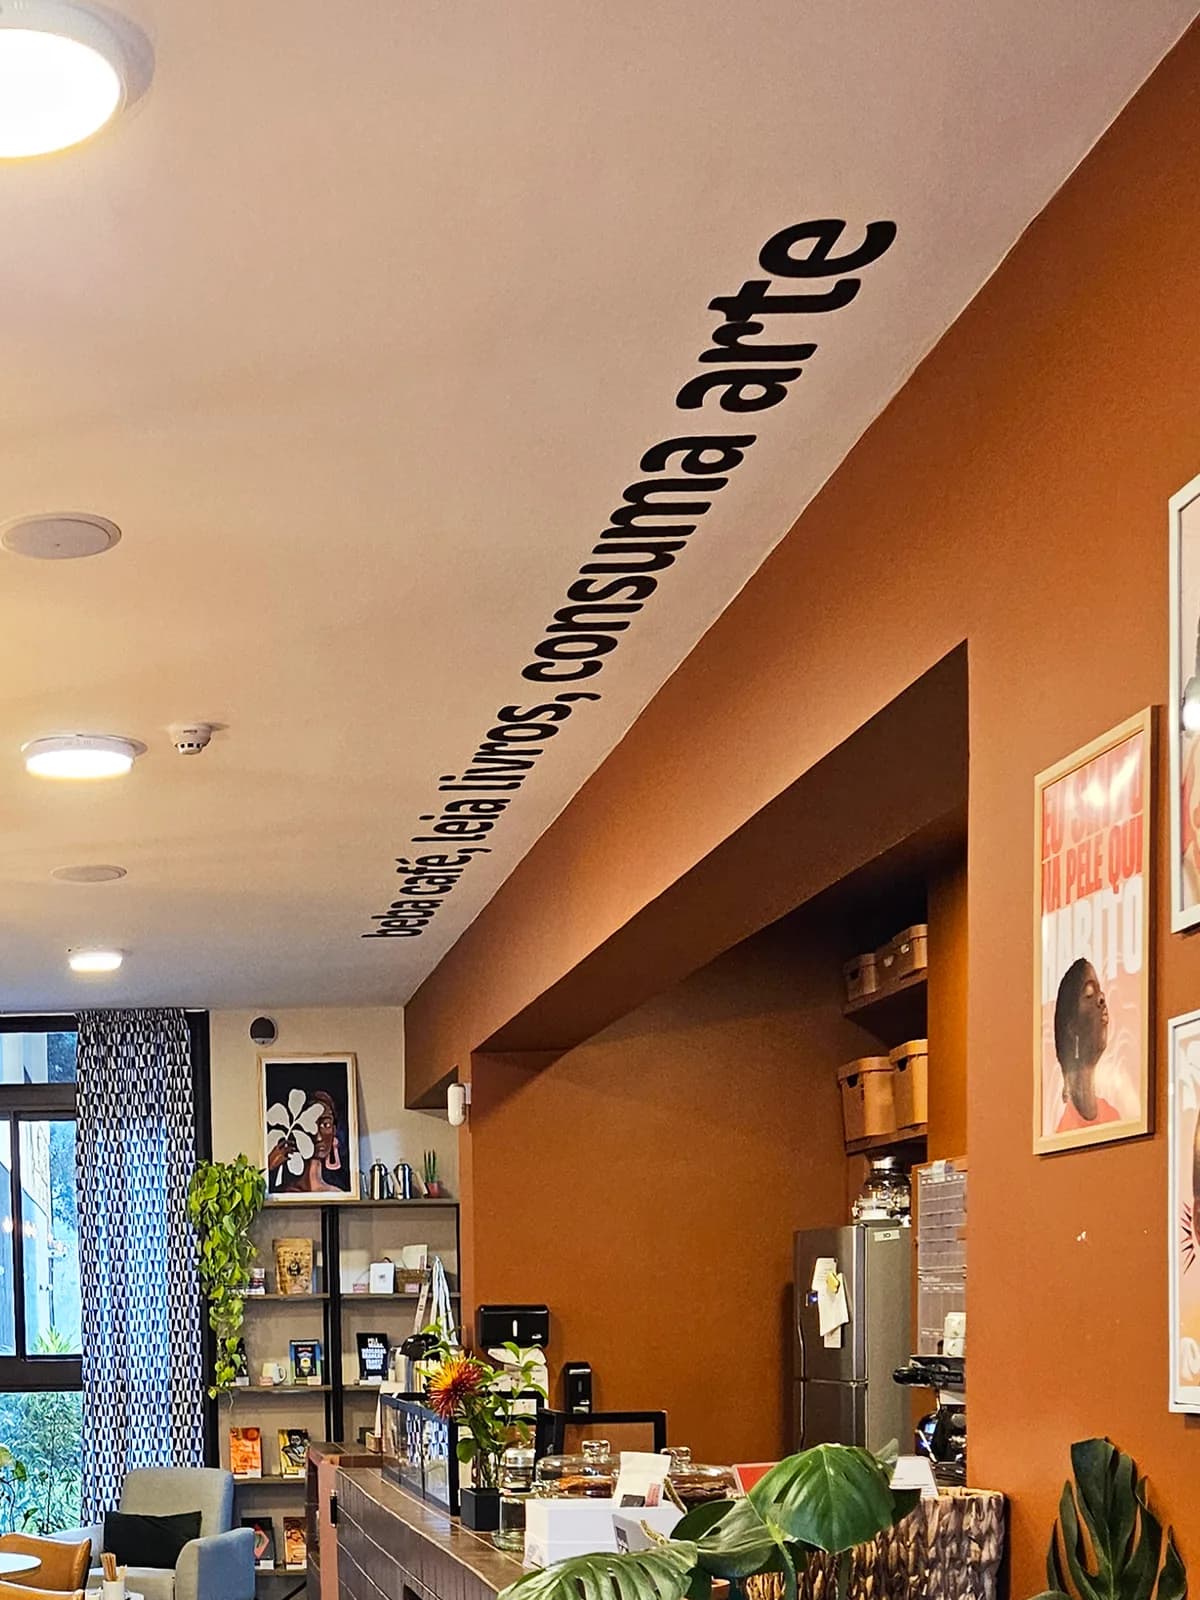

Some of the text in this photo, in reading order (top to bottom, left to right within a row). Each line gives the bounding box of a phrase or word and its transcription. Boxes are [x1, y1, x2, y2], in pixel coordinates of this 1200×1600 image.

[361, 218, 897, 938] beba café, leia livros, consuma arte
[1066, 835, 1103, 904] PELE
[1042, 876, 1143, 1004] HABITO
